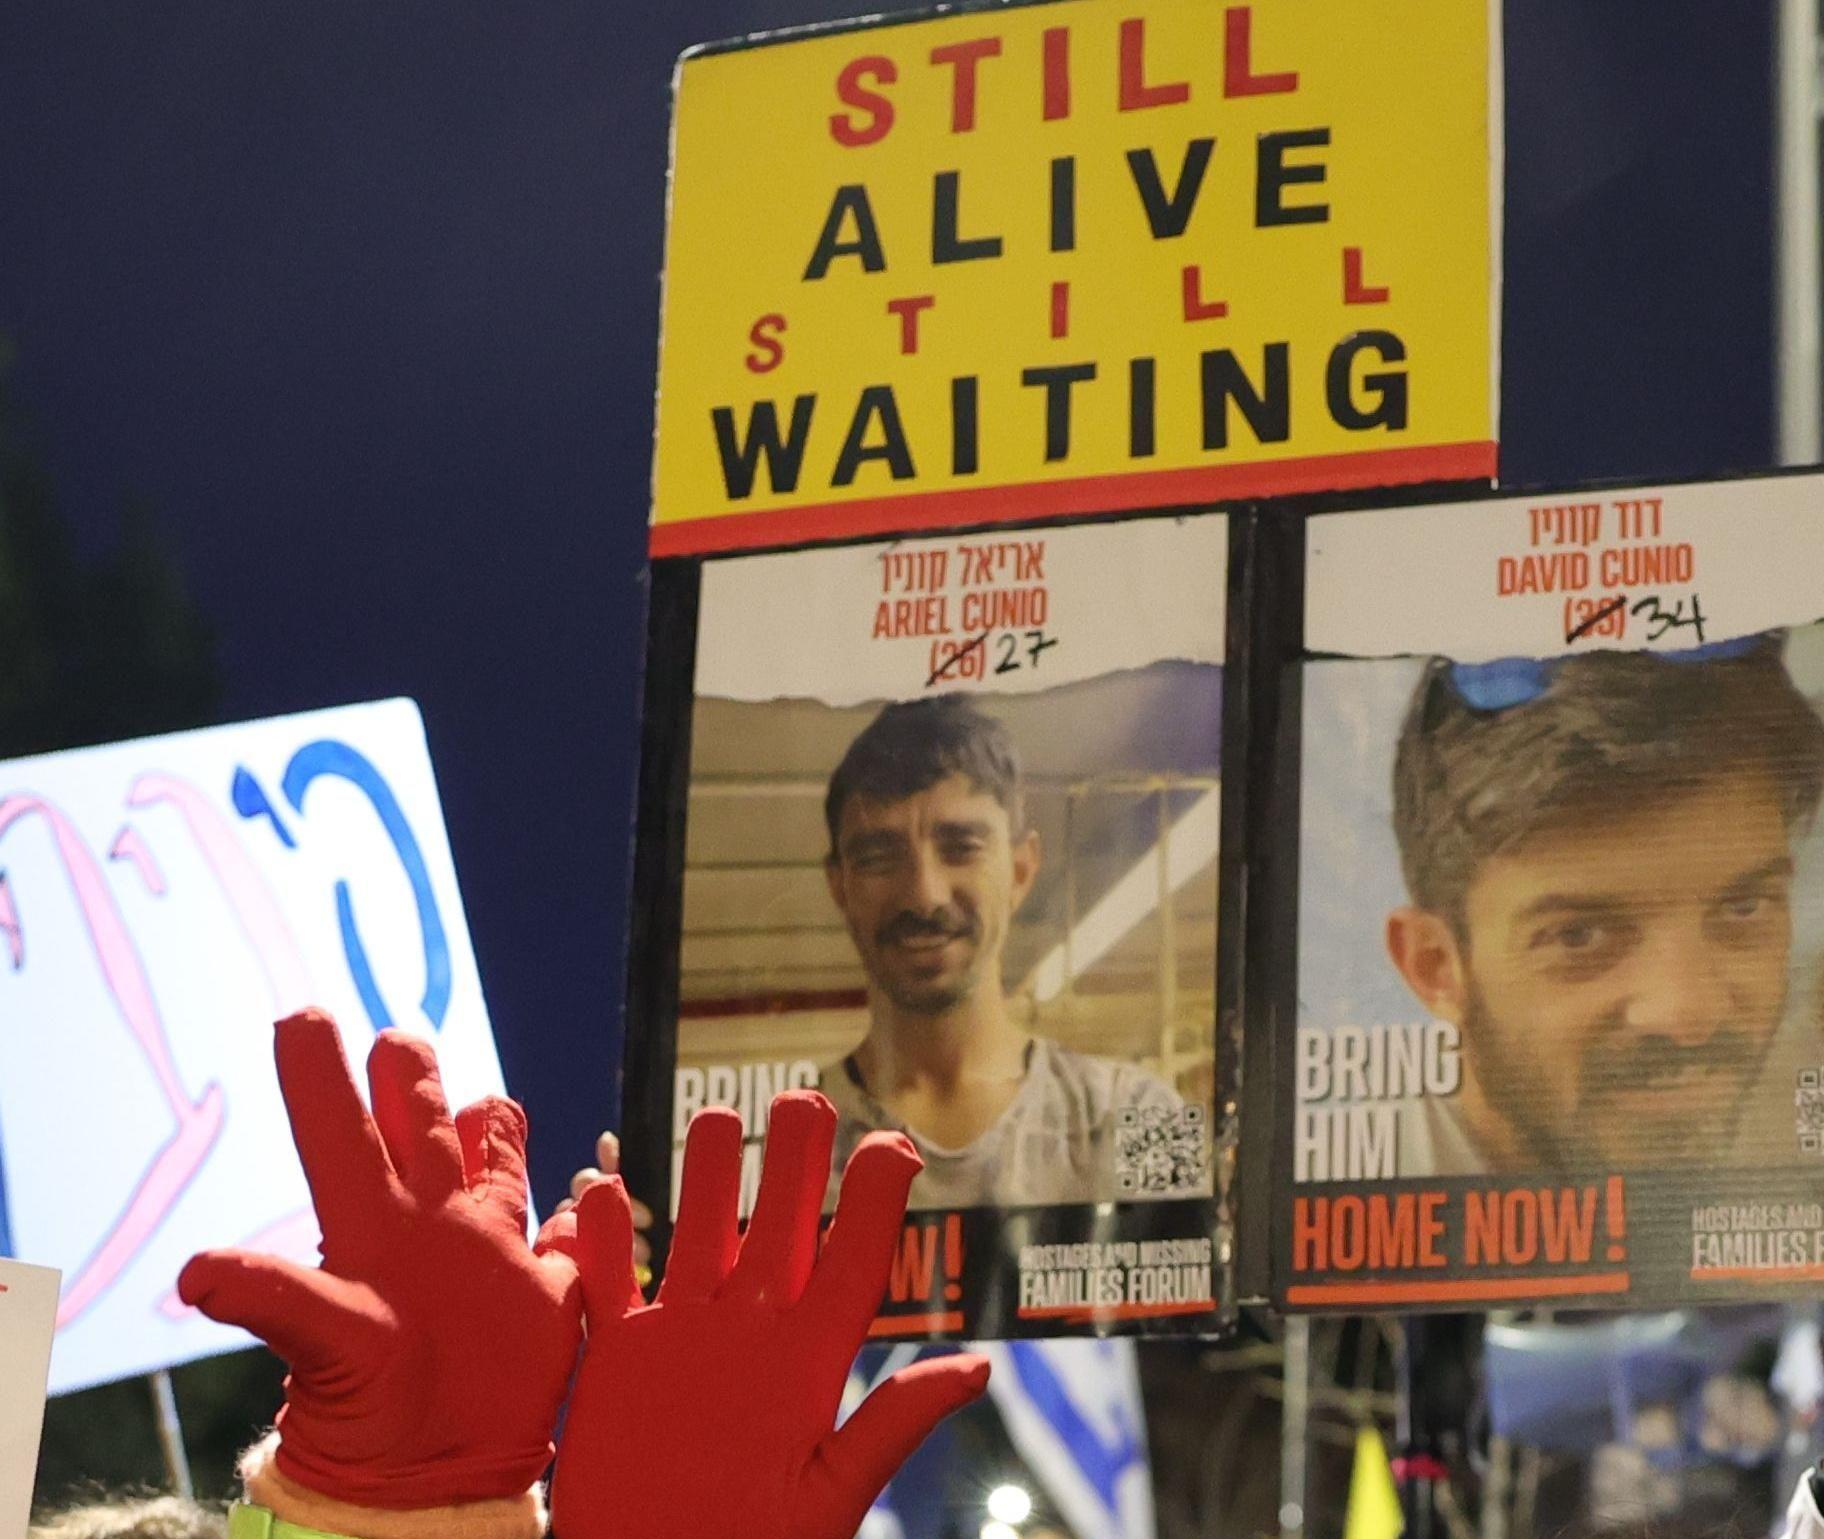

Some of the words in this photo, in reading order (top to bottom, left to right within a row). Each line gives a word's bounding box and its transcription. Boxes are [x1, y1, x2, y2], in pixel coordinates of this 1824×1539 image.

[828, 6, 1299, 147] STILL
[802, 127, 1331, 281] ALIVE
[745, 247, 1390, 374] STILL
[712, 330, 1409, 500] WAITING
[1613, 498, 1663, 539] דוד
[957, 541, 1045, 586] אריאל
[1496, 551, 1589, 597] DAVID
[1601, 543, 1693, 588] CUNIO
[872, 596, 951, 639] ARIEL
[961, 587, 1047, 631] CUNIO
[1631, 593, 1707, 642] 34
[995, 630, 1058, 674] 27
[1296, 1020, 1461, 1100] BRING
[1293, 1101, 1398, 1183] HIM
[1292, 1187, 1448, 1273] HOME
[1464, 1175, 1626, 1265] NOW!
[1692, 1204, 1783, 1231] HOSTAGES
[1693, 1230, 1807, 1269] FAMILIES
[1020, 1268, 1125, 1308] FAMILIES
[1128, 1265, 1211, 1305] FORUM
